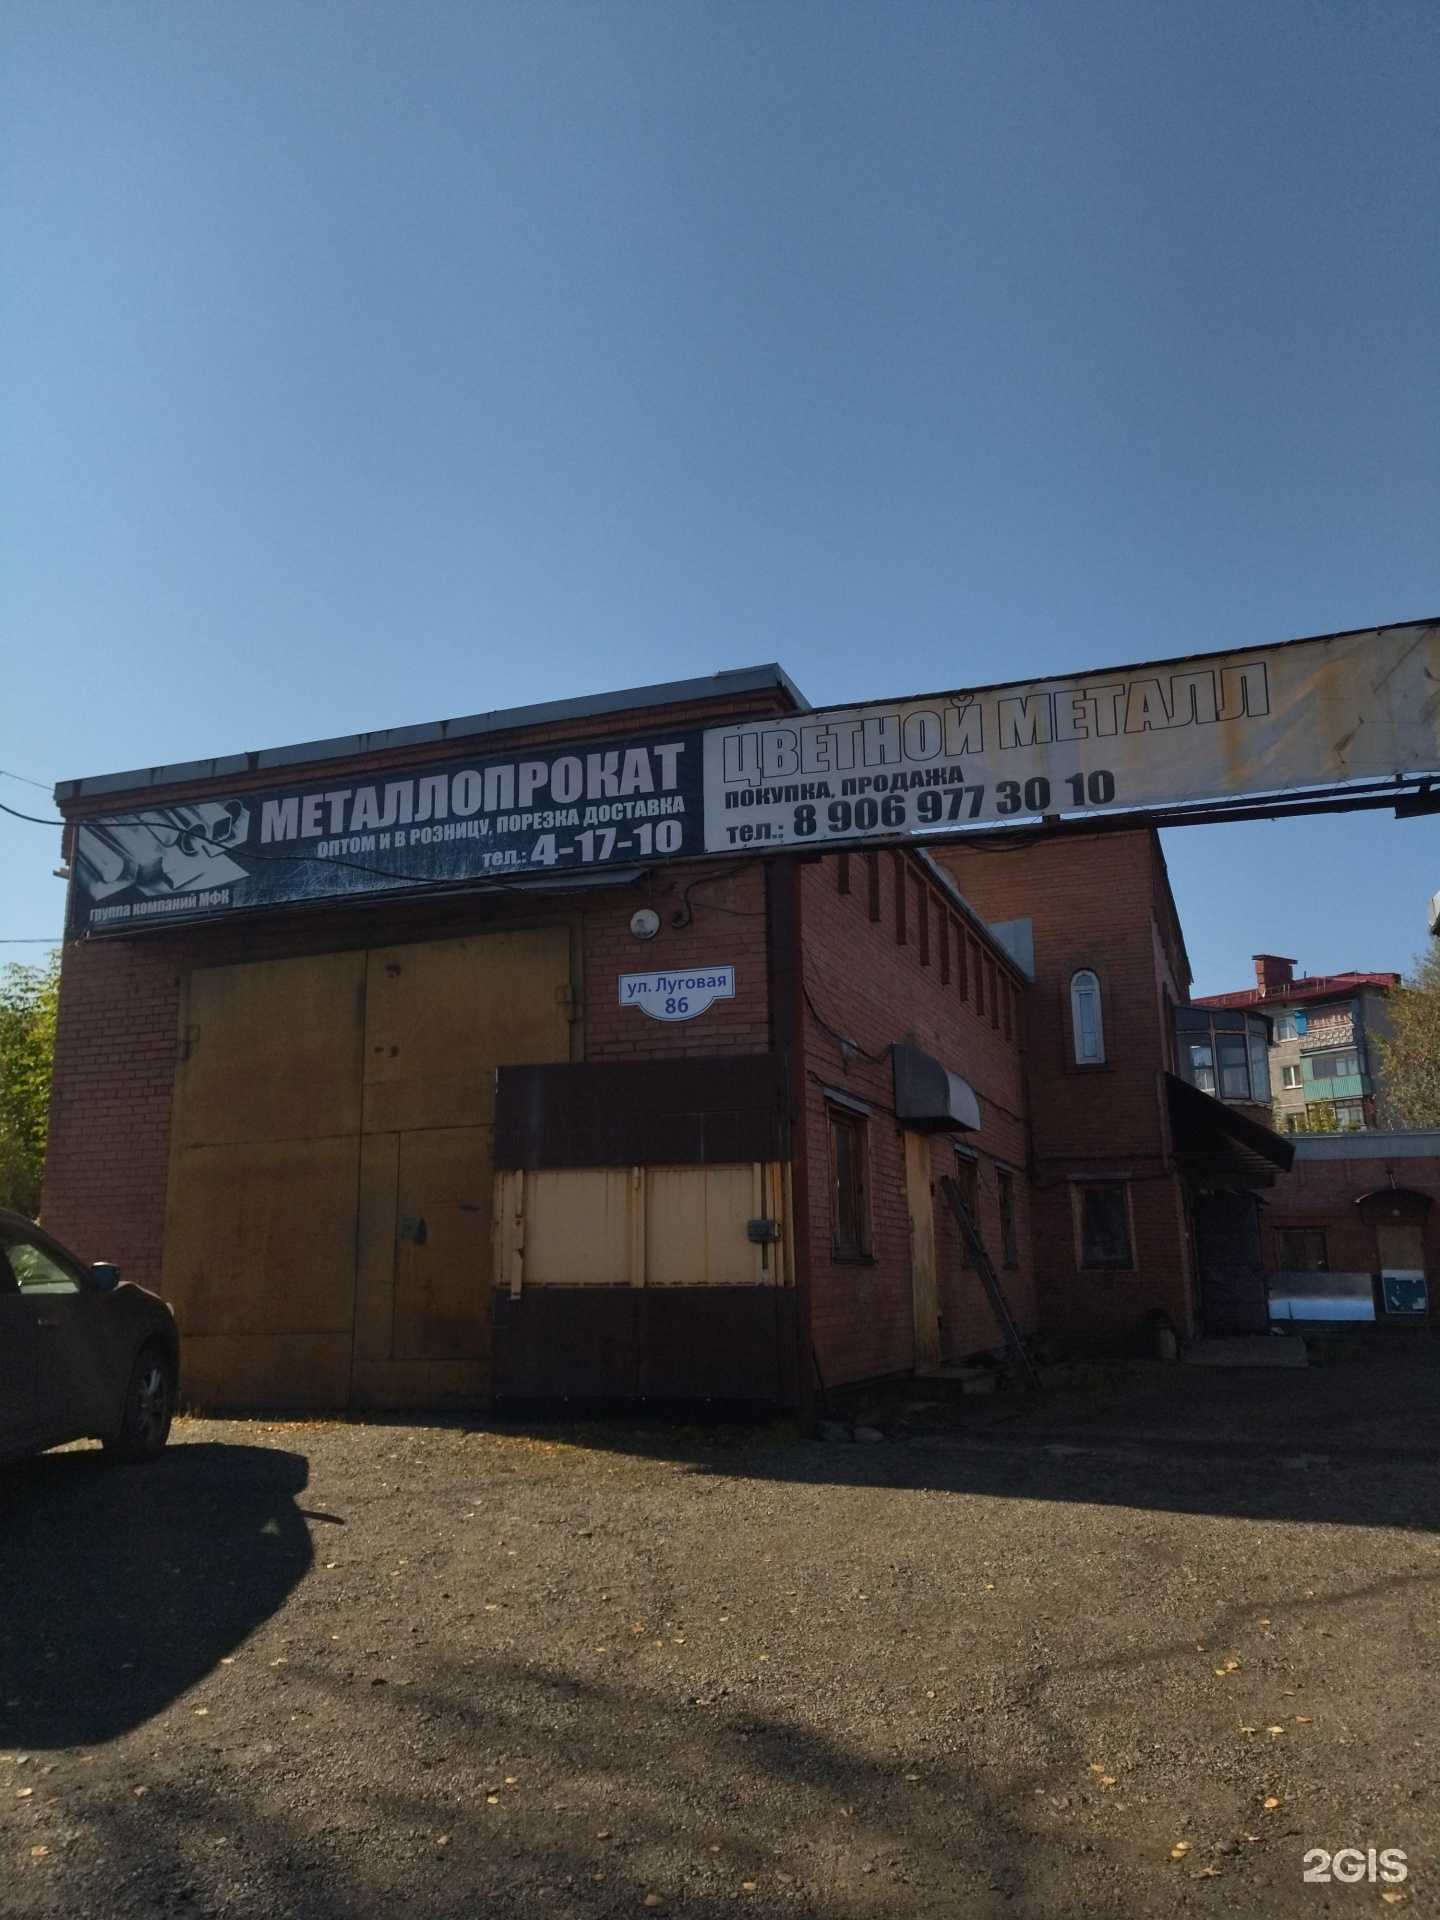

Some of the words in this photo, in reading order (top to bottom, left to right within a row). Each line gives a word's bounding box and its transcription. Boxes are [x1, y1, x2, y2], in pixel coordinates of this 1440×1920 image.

[722, 695, 984, 787] ЦВЕТНОЙ
[998, 662, 1270, 750] МЕТАЛЛ
[260, 742, 685, 844] МЕТАЛЛОПРОКАТ
[724, 778, 836, 810] ПОКУПКА,
[841, 765, 965, 797] ПРОДАЖА
[727, 823, 785, 845] тел.:
[793, 804, 817, 837] 8
[828, 795, 906, 833] 906
[917, 786, 985, 824] 977
[995, 777, 1052, 815] 30
[1064, 769, 1116, 807] 10
[317, 834, 376, 859] ОПТОМ
[379, 832, 391, 850] И
[394, 831, 406, 849] В
[409, 817, 494, 847] РОЗНИЦУ,
[496, 811, 580, 834] ПОРЕЗКА
[583, 795, 686, 826] ДОСТАВКА
[482, 848, 527, 868] тел.:
[530, 819, 684, 866] 4-17-10
[89, 904, 131, 922] группа
[133, 894, 198, 917] компаний
[199, 887, 230, 908] МФК
[627, 981, 652, 998] ул.
[655, 974, 728, 995] Луговая
[664, 996, 690, 1015] 86
